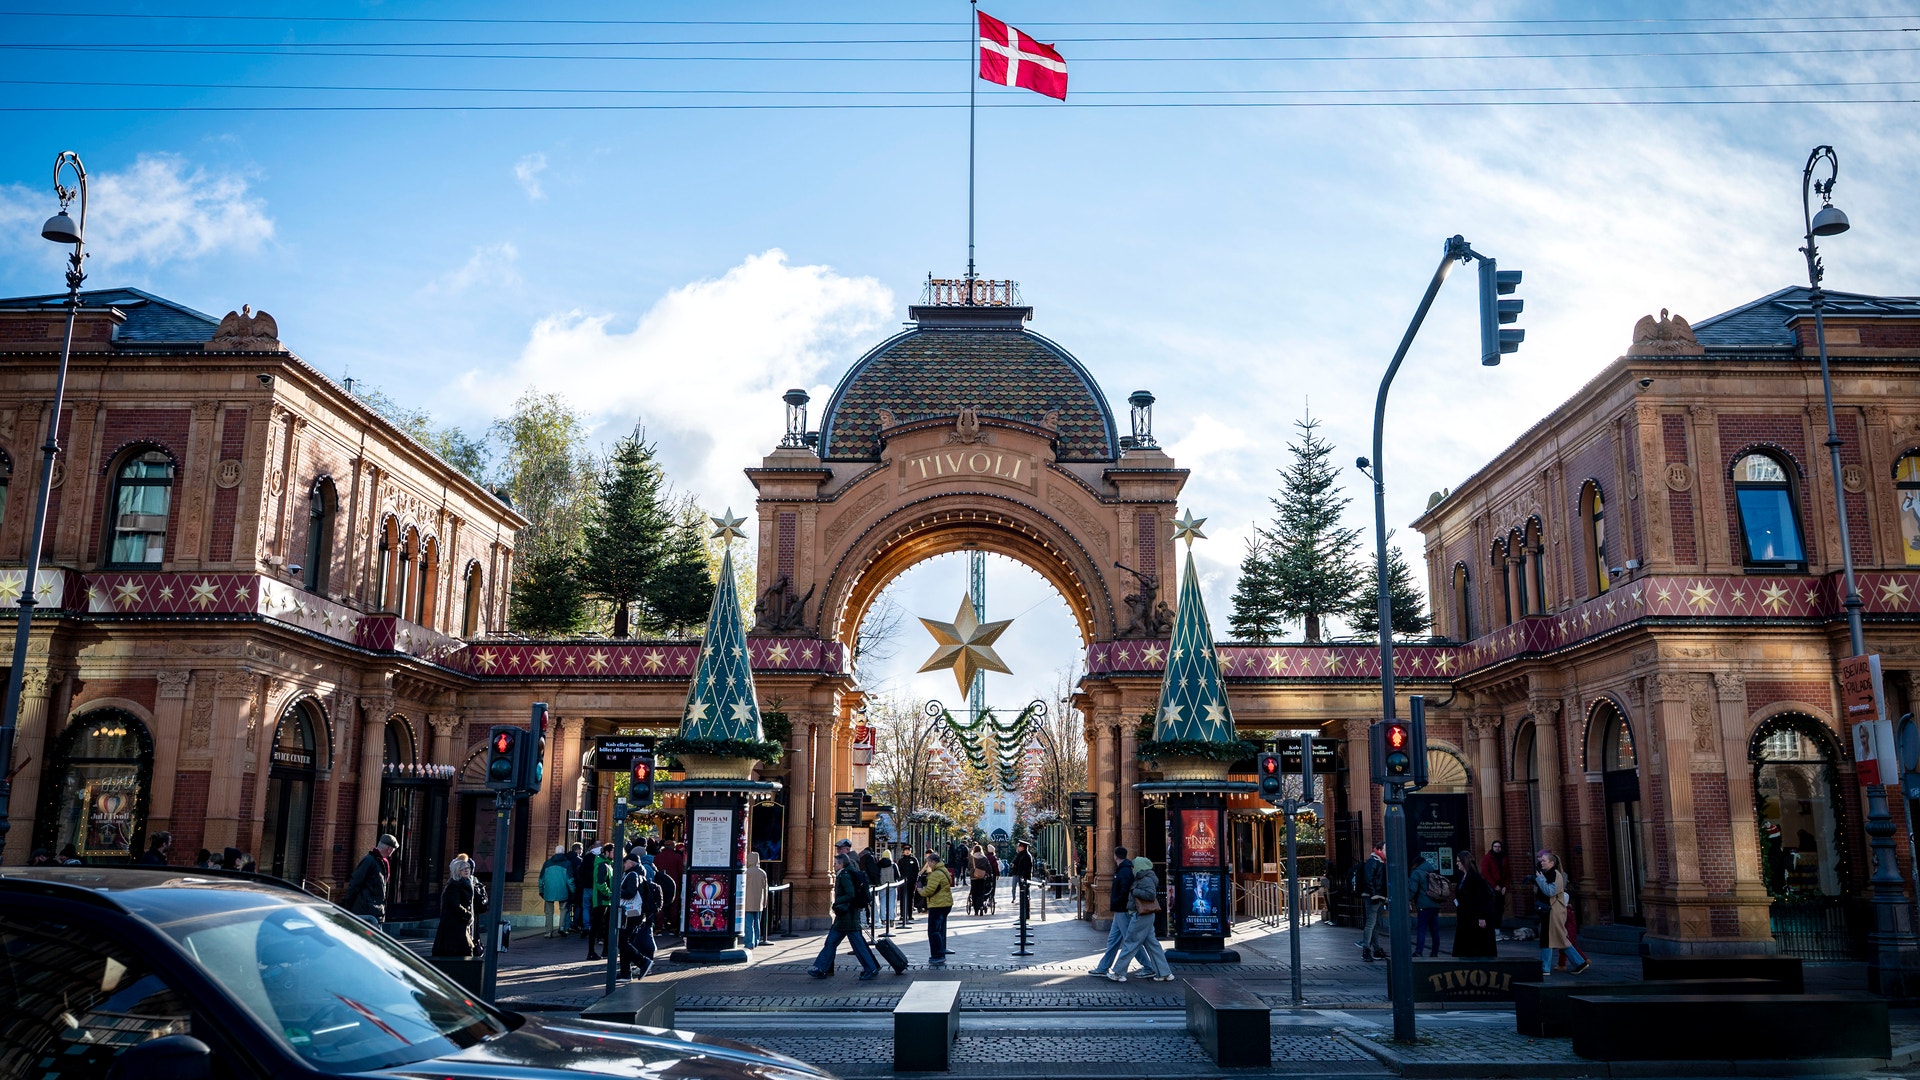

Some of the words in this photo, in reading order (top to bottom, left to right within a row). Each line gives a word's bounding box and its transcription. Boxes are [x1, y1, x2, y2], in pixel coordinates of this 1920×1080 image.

[931, 278, 1010, 306] TIVOLI
[911, 452, 1022, 480] TIVOLI
[1843, 662, 1870, 678] BEVAR
[290, 753, 311, 765] CENTER
[1185, 835, 1216, 845] TINKAS
[1428, 969, 1512, 992] TIVOLI
